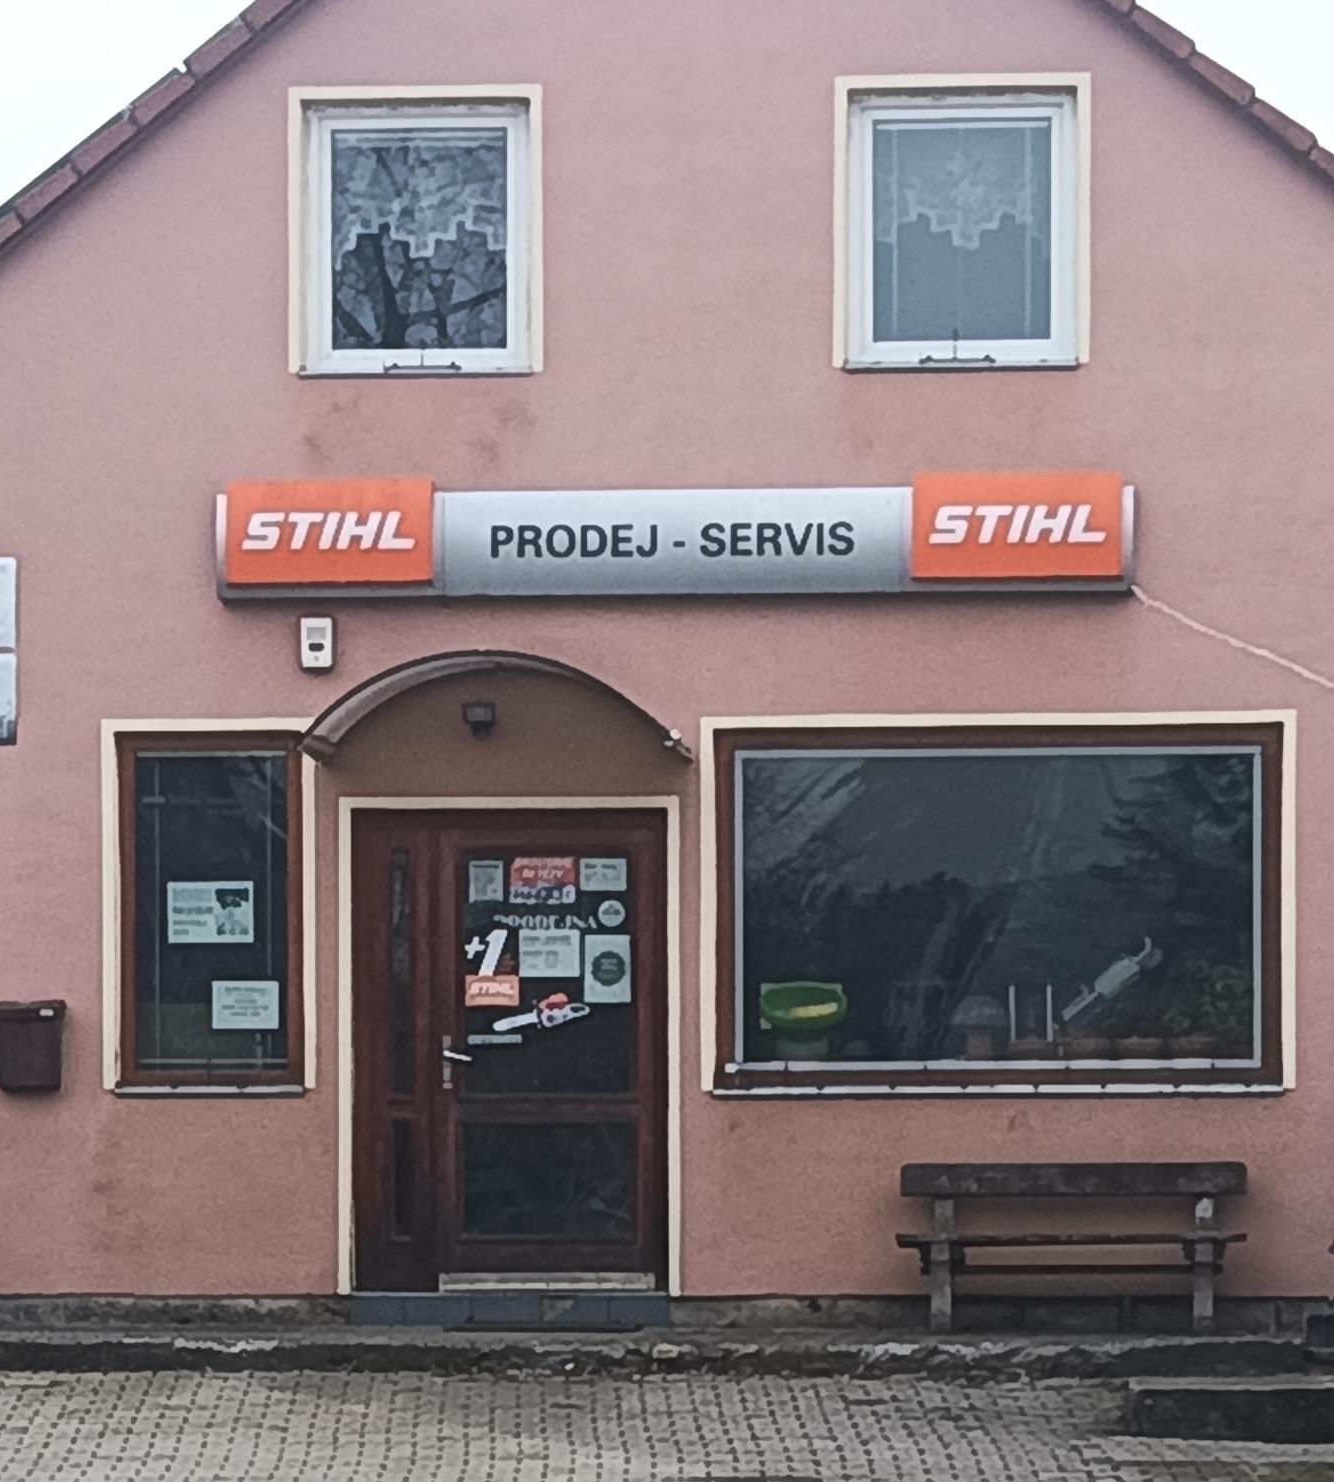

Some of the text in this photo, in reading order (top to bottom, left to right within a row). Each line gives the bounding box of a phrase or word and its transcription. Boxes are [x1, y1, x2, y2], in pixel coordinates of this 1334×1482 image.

[242, 511, 415, 550] STIHL
[491, 524, 658, 558] PRODEJ
[700, 521, 855, 557] SERVIS
[929, 504, 1107, 543] STIHL
